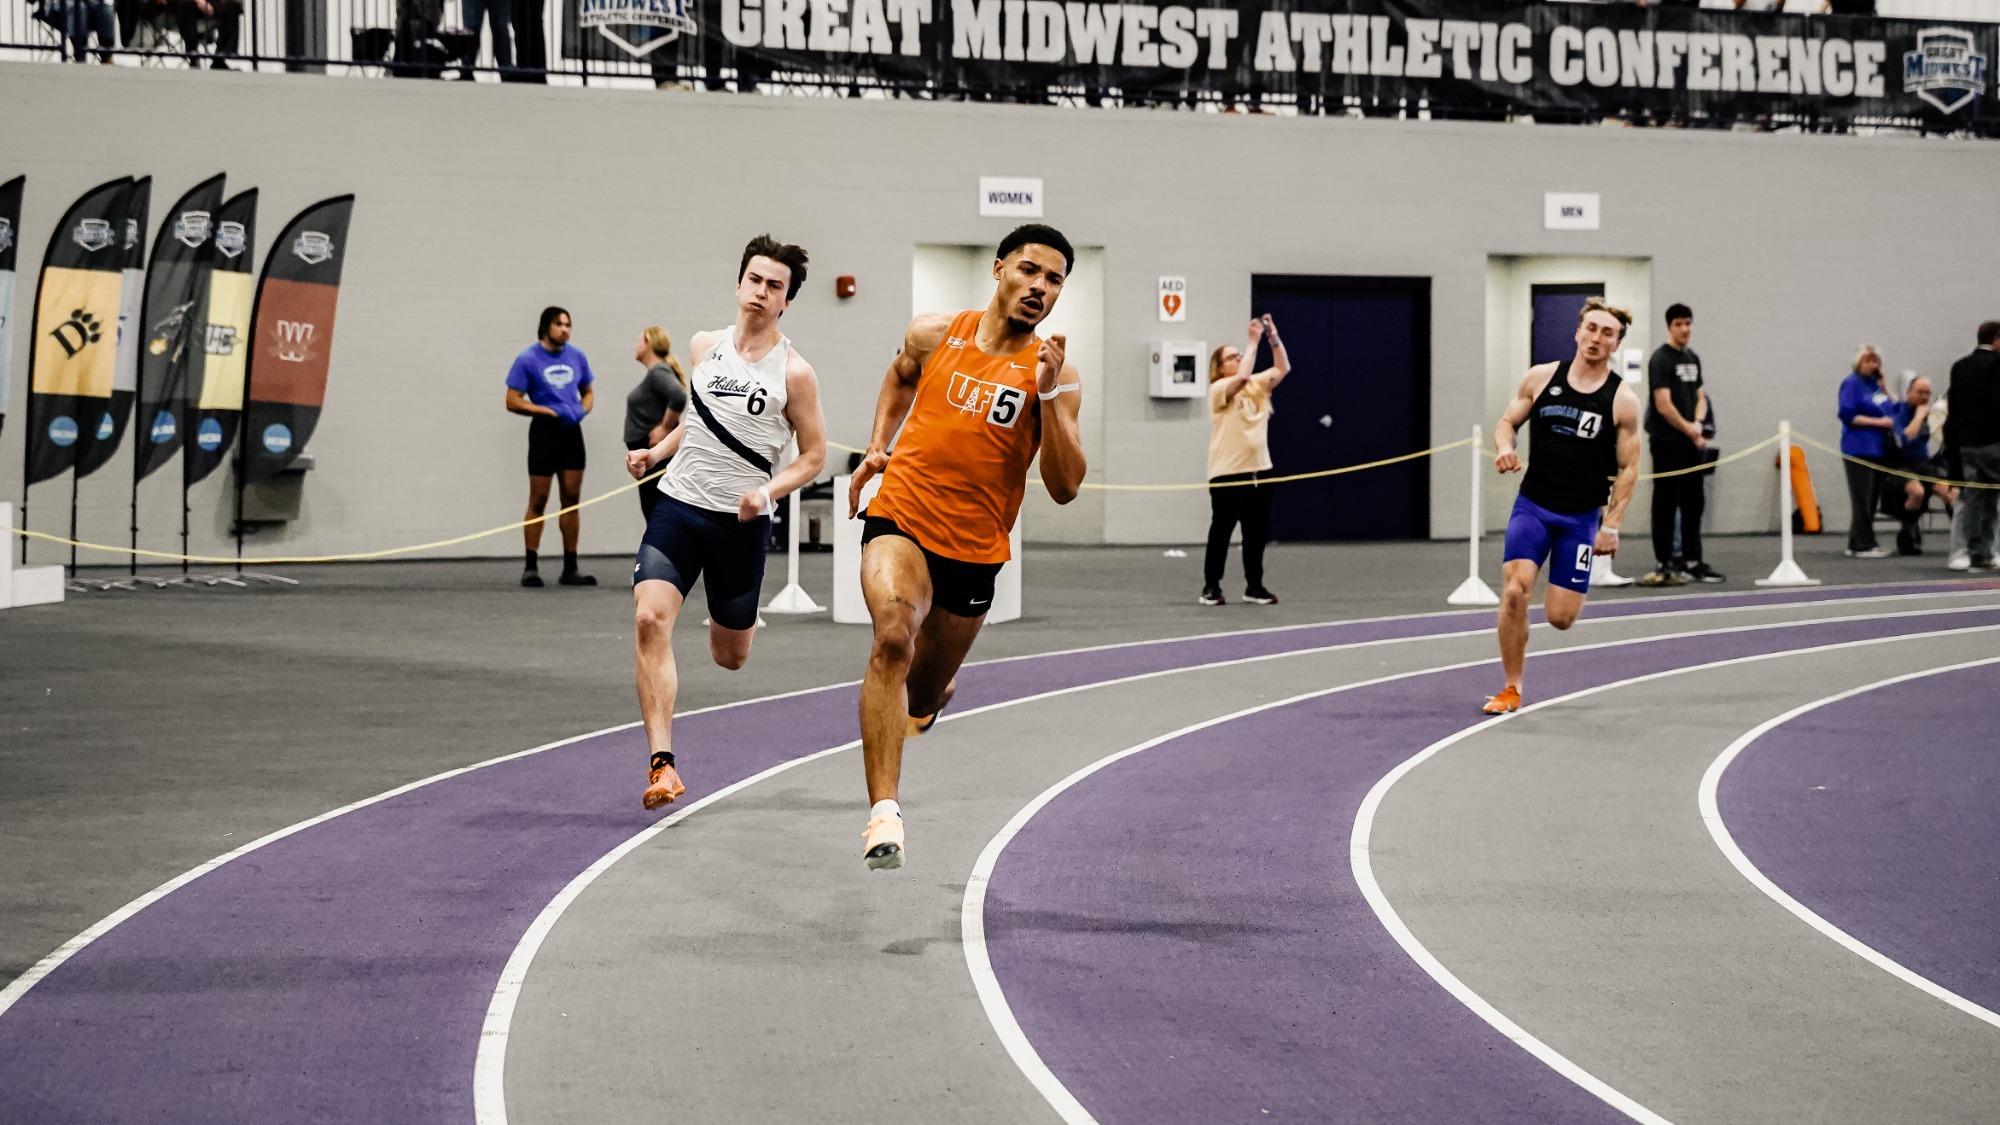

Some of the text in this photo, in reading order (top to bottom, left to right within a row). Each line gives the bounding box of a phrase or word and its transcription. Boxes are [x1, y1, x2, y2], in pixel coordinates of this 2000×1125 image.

[721, 0, 1886, 97] GREAT MIDWEST ATHLETIC CONFERENCE
[988, 192, 1033, 204] WOMEN
[1561, 206, 1583, 217] MEN
[1162, 281, 1184, 291] AED
[747, 388, 768, 416] 6
[993, 389, 1020, 424] 5
[1581, 416, 1596, 437] 4
[1579, 547, 1590, 569] 4
